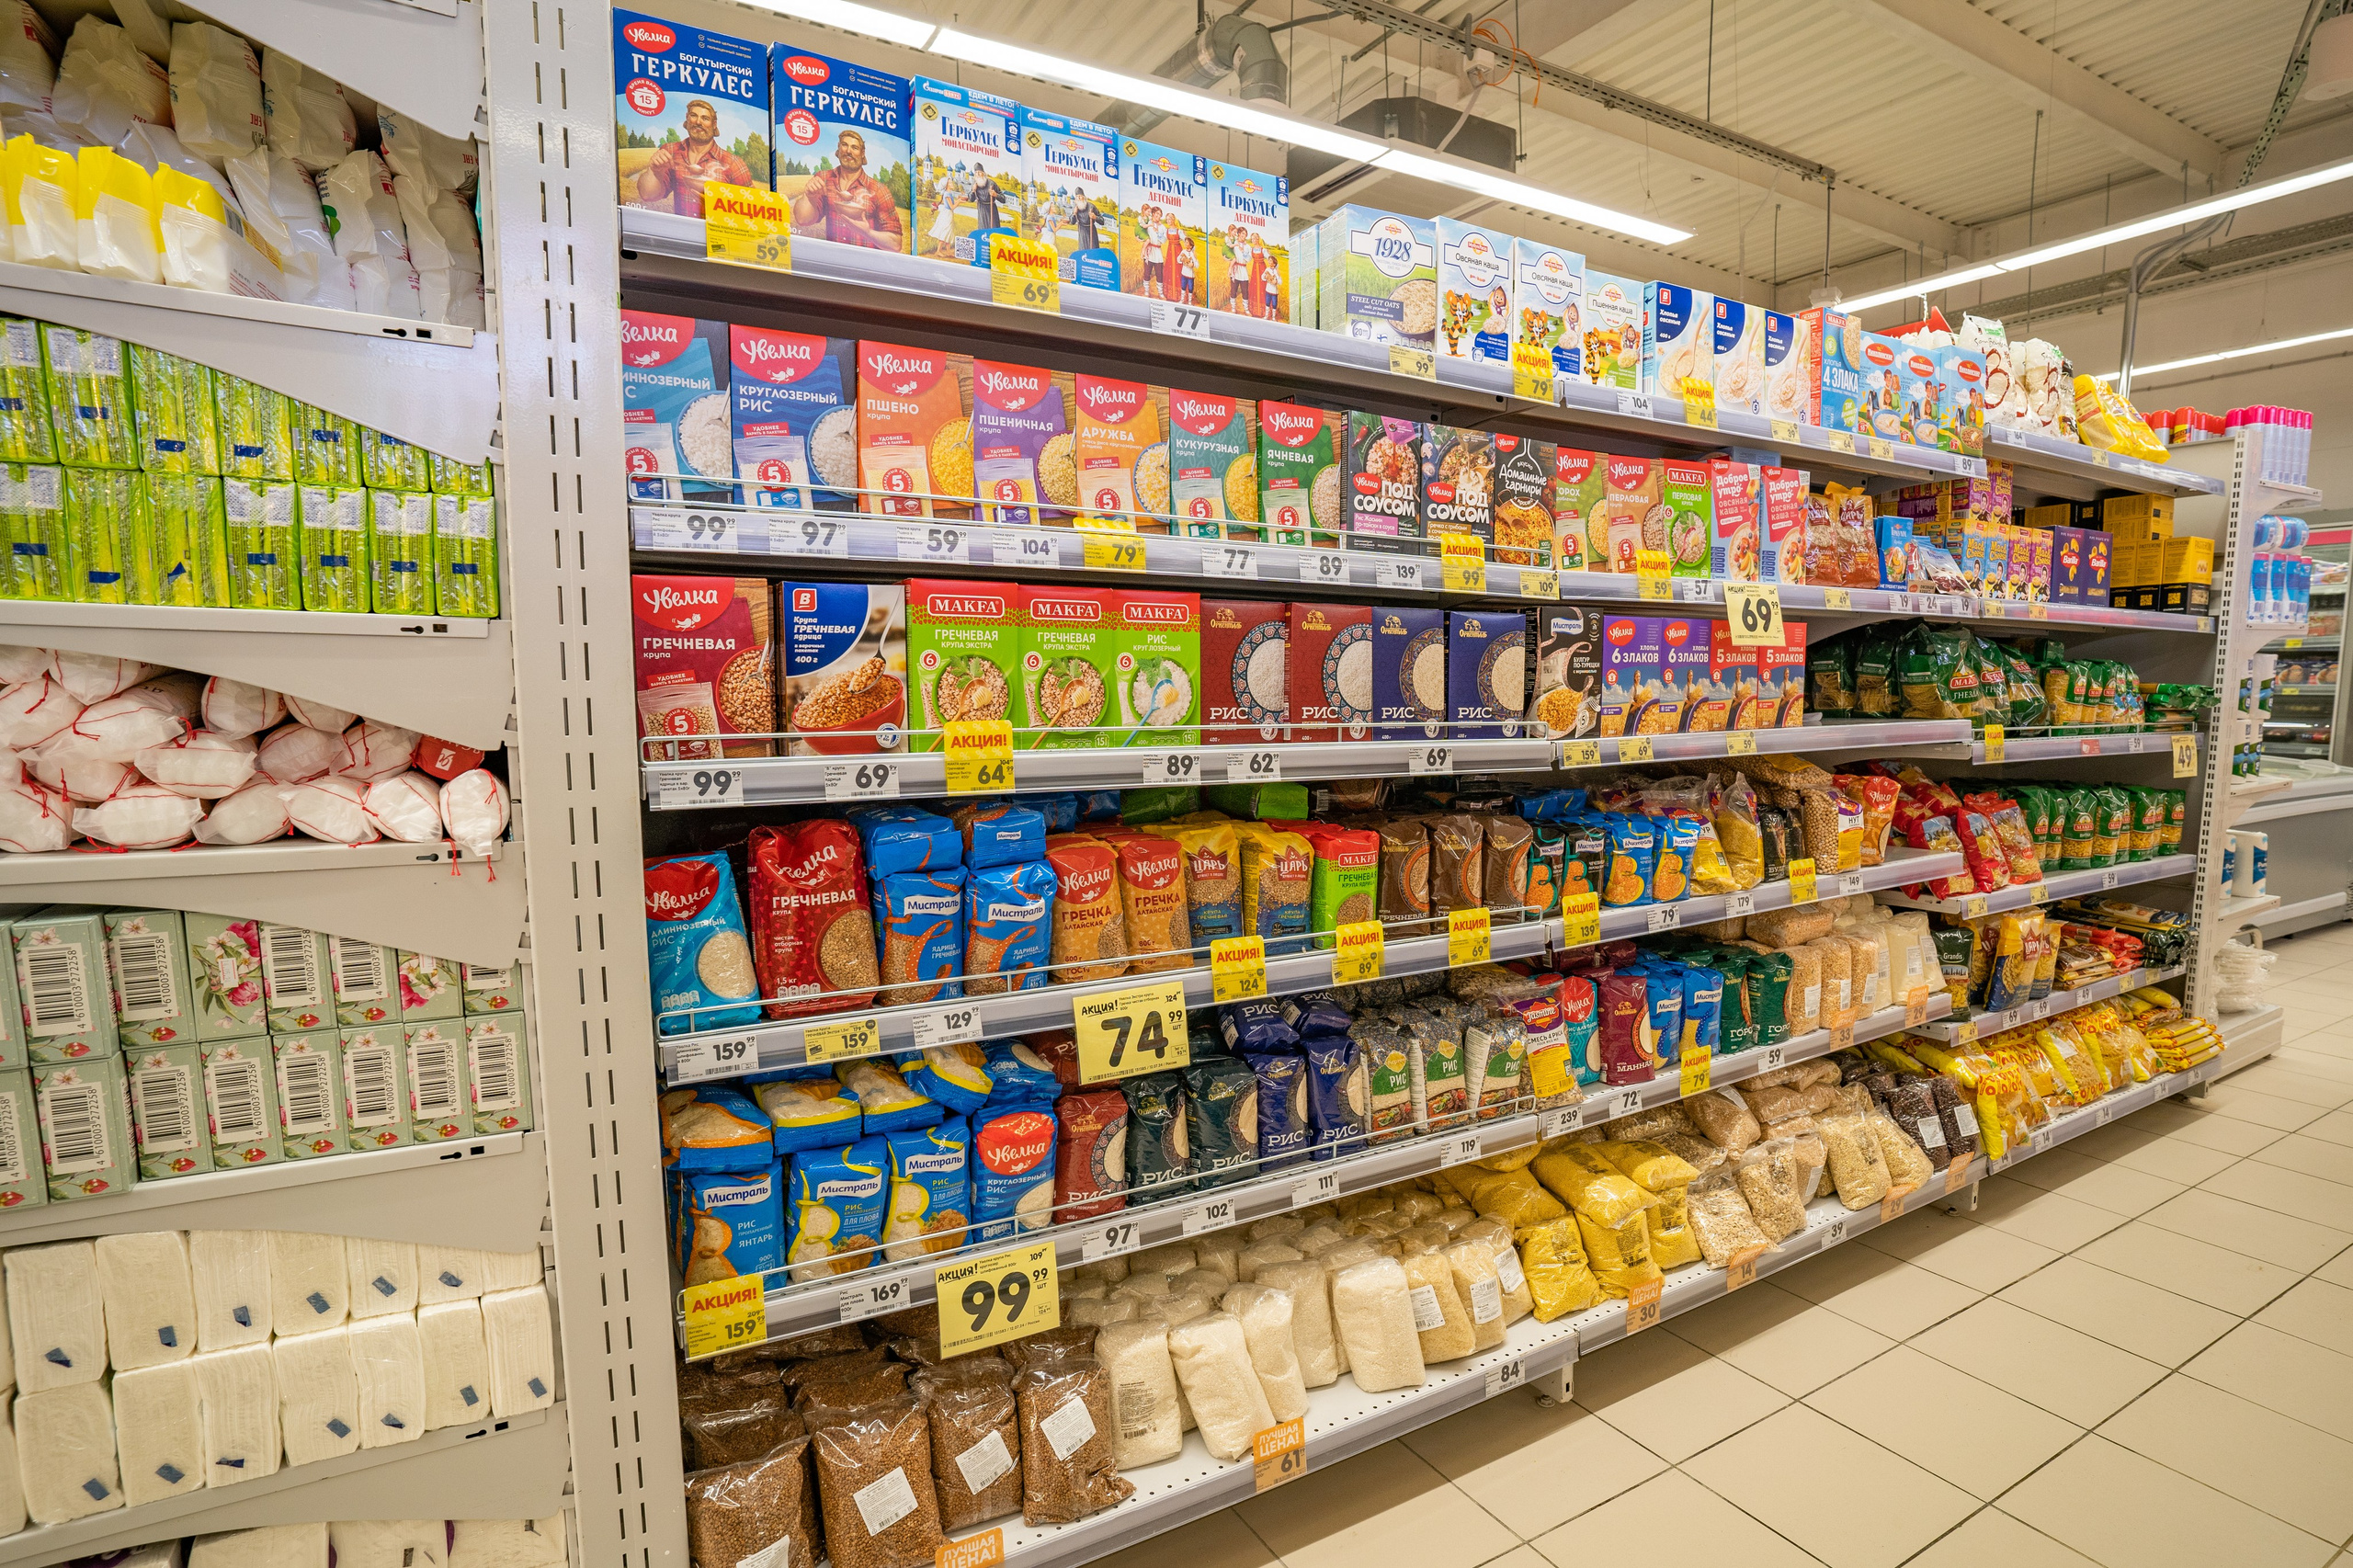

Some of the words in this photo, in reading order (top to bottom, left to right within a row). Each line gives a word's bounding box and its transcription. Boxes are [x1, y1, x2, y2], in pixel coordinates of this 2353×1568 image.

[679, 52, 753, 77] БОГАТЫРСКИЙ
[632, 52, 753, 98] ГЕРКУЛЕС
[833, 85, 896, 109] БОГАТЫРСКИЙ
[969, 91, 988, 100] ЕДЕМ
[995, 97, 1015, 108] ЛЕТО!
[790, 85, 897, 130] ГЕРКУЛЕС
[941, 117, 999, 148] ГЕРКУЛЕС
[1070, 119, 1087, 128] ЕДЕМ
[1095, 126, 1113, 135] ЛЕТО!
[942, 138, 999, 158] МОНАСТЫРСКИЙ
[1044, 144, 1098, 174] ГЕРКУЛЕС
[1044, 165, 1099, 182] МОНАСТЫРСКИЙ
[1133, 164, 1194, 199] ГЕРКУЛЕС
[1148, 191, 1182, 208] ДЕТСКИЙ
[1221, 187, 1278, 219] ГЕРКУЛЕС
[713, 198, 782, 222] АКЦИЯ!
[1234, 212, 1266, 227] ДЕТСКИЙ
[756, 244, 779, 261] 59
[1374, 236, 1411, 262] 1928
[996, 248, 1052, 269] АКЦИЯ!
[1456, 254, 1483, 267] Овсяная
[1483, 260, 1499, 271] каша
[1532, 272, 1558, 284] Овсяная
[1559, 278, 1573, 288] каша
[1023, 283, 1049, 304] 69
[1351, 296, 1369, 304] STEEL
[1593, 300, 1618, 312] Пшенная
[1619, 305, 1632, 314] каша
[1660, 309, 1678, 319] Хлопья
[1174, 307, 1201, 330] 77
[1717, 322, 1733, 331] Хлопья
[621, 321, 678, 344] велка
[741, 338, 811, 364] Увелка
[869, 355, 932, 378] Увелка
[1415, 360, 1429, 373] 99
[1517, 353, 1550, 369] АКЦИЯ!
[981, 371, 1039, 393] Увелка
[1532, 380, 1548, 395] 79
[1823, 370, 1830, 385] 4
[1832, 371, 1859, 391] ЗЛАКА
[739, 385, 837, 404] КРУГЛОЗЕРНЫЙ
[1084, 386, 1136, 406] Увелка
[1686, 387, 1712, 399] АКЦИЯ!
[739, 399, 772, 413] РИС
[867, 400, 919, 415] ПШЕНО
[1177, 400, 1225, 419] Увелка
[1632, 397, 1648, 409] 104
[979, 415, 1053, 432] ПШЕНИЧНАЯ
[1700, 411, 1712, 423] 44
[1082, 426, 1134, 443] ДРУЖБА
[1787, 428, 1795, 438] 39
[1176, 439, 1239, 454] КУКУРУЗНАЯ
[1843, 439, 1851, 449] 64
[1267, 449, 1314, 465] ЯЧНЕВАЯ
[1499, 465, 1547, 486] Домашние
[1610, 464, 1643, 479] Увелка
[1672, 472, 1702, 483] MAKFA
[1357, 475, 1379, 490] Увелка
[1381, 481, 1414, 499] ПОД
[1430, 485, 1452, 500] Увелка
[1455, 490, 1487, 506] ПОД
[1610, 494, 1648, 504] ПЕРЛОВАЯ
[1672, 492, 1701, 502] ПЕРЛОВАЯ
[1354, 494, 1415, 517] СОУСОМ
[1427, 504, 1490, 524] СОУСОМ
[688, 516, 726, 541] 99
[801, 521, 837, 546] 97
[926, 529, 959, 552] 59
[1021, 540, 1050, 555] 104
[1112, 543, 1137, 563] 79
[1446, 545, 1481, 557] АКЦИЯ!
[1224, 550, 1249, 569] 77
[1320, 557, 1342, 576] 89
[1640, 559, 1668, 571] АКЦИЯ!
[2063, 555, 2078, 564] Barilla
[2091, 559, 2107, 568] Barilla
[1396, 565, 1415, 579] 139
[1462, 570, 1480, 585] 99
[1539, 582, 1553, 594] 109
[643, 588, 718, 612] Увелка
[935, 599, 998, 613] MAKFA
[1038, 603, 1096, 617] MAKFA
[1130, 608, 1184, 620] MAKFA
[1742, 597, 1771, 632] 69
[794, 616, 817, 625] Крупа
[794, 625, 856, 634] ГРЕЧНЕВАЯ
[935, 630, 998, 642] ГРЕЧНЕВАЯ
[1038, 632, 1096, 643] ГРЕЧНЕВАЯ
[643, 638, 735, 651] ГРЕЧНЕВАЯ
[1147, 635, 1167, 644] РИС
[795, 655, 810, 664] 400
[1611, 649, 1620, 664] 6
[1623, 653, 1659, 663] ЗЛАКОВ
[1211, 708, 1248, 720] РИС
[1302, 707, 1338, 719] РИС
[1381, 708, 1415, 719] РИС
[950, 734, 1006, 749] АКЦИЯ!
[1249, 754, 1273, 773] 62
[1427, 748, 1447, 767] 69
[2178, 744, 2192, 767] 49
[1167, 755, 1193, 776] 89
[856, 765, 889, 789] 69
[978, 765, 1006, 784] 64
[693, 771, 732, 796] 99
[1848, 816, 1859, 824] НУТ
[1131, 857, 1178, 881] Увелка
[1058, 868, 1110, 895] Увелка
[645, 886, 710, 912] Увелка
[773, 890, 856, 908] ГРЕЧНЕВАЯ
[908, 899, 960, 911] Мистраль
[1135, 894, 1180, 907] ГРЕЧКА
[992, 904, 1043, 918] Мистраль
[1063, 906, 1112, 922] ГРЕЧКА
[1566, 903, 1596, 914] АКЦИЯ!
[1063, 921, 1103, 931] АЛТАЙСКАЯ
[1580, 926, 1595, 937] 139
[653, 936, 675, 948] РИС
[1341, 934, 1380, 947] АКЦИЯ!
[1216, 949, 1260, 963] АКЦИЯ!
[1943, 952, 1963, 960] Grandis
[68, 949, 80, 982] 272258
[1358, 962, 1371, 973] 89
[1239, 979, 1258, 992] 124
[74, 986, 85, 1017] 610003
[1082, 1000, 1118, 1016] АКЦИЯ!
[944, 1012, 972, 1028] 129
[1528, 1006, 1556, 1022] Jasmine
[842, 1031, 869, 1049] 159
[1101, 1011, 1168, 1067] 74
[1168, 1010, 1182, 1022] 99
[712, 1042, 746, 1061] 159
[1561, 1110, 1578, 1123] 239
[988, 1142, 1045, 1165] Увелка
[1461, 1140, 1475, 1152] 119
[988, 1173, 1046, 1186] КРУГЛОЗЕРНЫЙ
[707, 1186, 768, 1204] Мистраль
[1206, 1203, 1228, 1219] 102
[738, 1220, 756, 1230] РИС
[739, 1233, 773, 1247] ЯНТАРЬ
[1106, 1225, 1131, 1246] 97
[938, 1263, 978, 1283] АКЦИЯ!
[692, 1288, 756, 1312] АКЦИЯ!
[871, 1283, 900, 1302] 169
[961, 1271, 1030, 1333] 99
[1033, 1267, 1048, 1280] 99
[1641, 1302, 1657, 1319] 30
[725, 1320, 756, 1339] 159
[1501, 1361, 1520, 1382] 84
[1258, 1423, 1299, 1446] ЛУЧШАЯ
[1259, 1433, 1300, 1459] ЦЕНА!
[1280, 1449, 1302, 1472] 61
[943, 1535, 995, 1562] ЛУЧШАЯ
